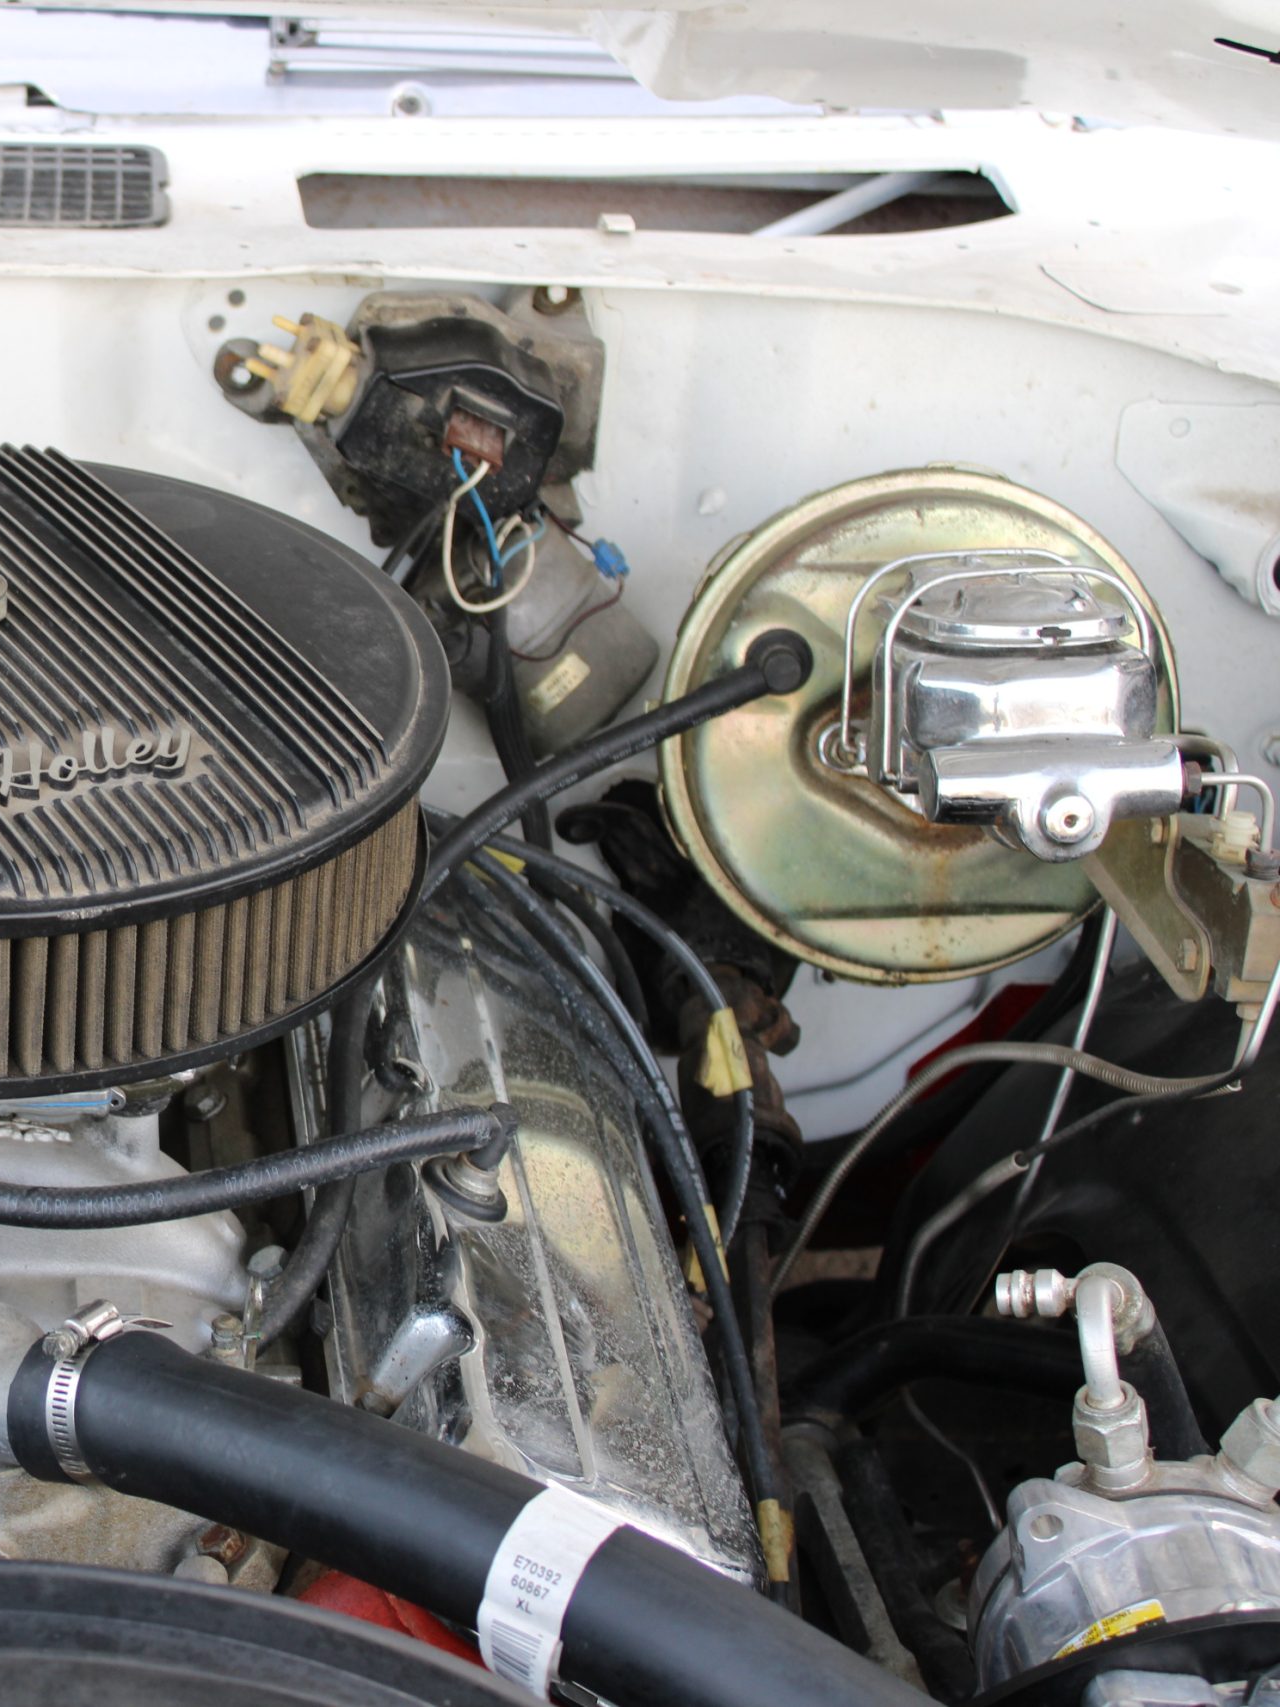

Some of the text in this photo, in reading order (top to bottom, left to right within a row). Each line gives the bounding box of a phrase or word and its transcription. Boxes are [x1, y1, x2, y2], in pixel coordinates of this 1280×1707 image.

[513, 1554, 562, 1586] E70392
[511, 1574, 550, 1600] 60867
[515, 1597, 533, 1615] XL
